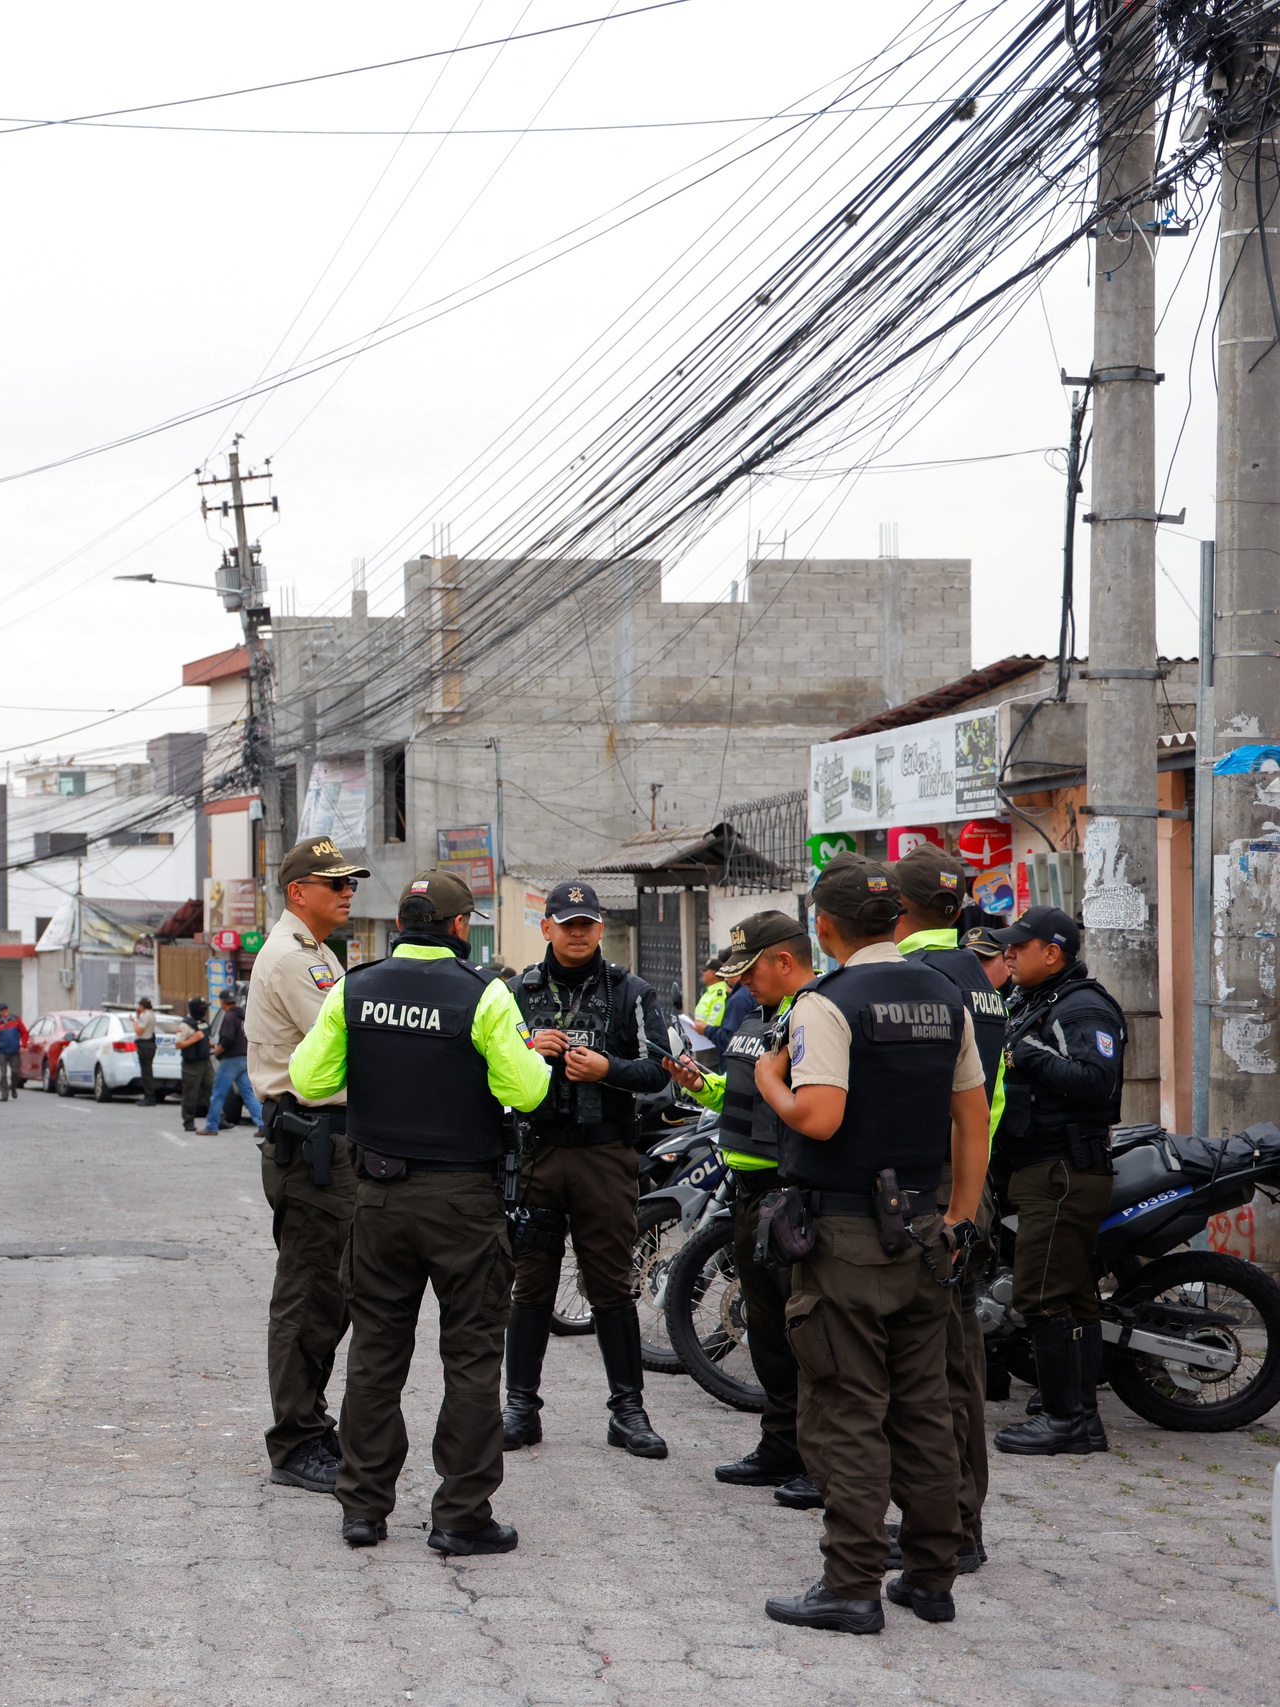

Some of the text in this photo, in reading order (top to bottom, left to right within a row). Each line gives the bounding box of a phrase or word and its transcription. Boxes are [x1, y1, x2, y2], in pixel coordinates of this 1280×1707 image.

[1096, 902, 1142, 912] DORMITORIOS
[873, 1003, 951, 1025] POLICIA
[971, 991, 1005, 1016] POLICIA
[360, 1001, 441, 1030] POLICIA
[912, 1024, 951, 1039] NACIONAL
[1122, 1189, 1178, 1217] P 0353
